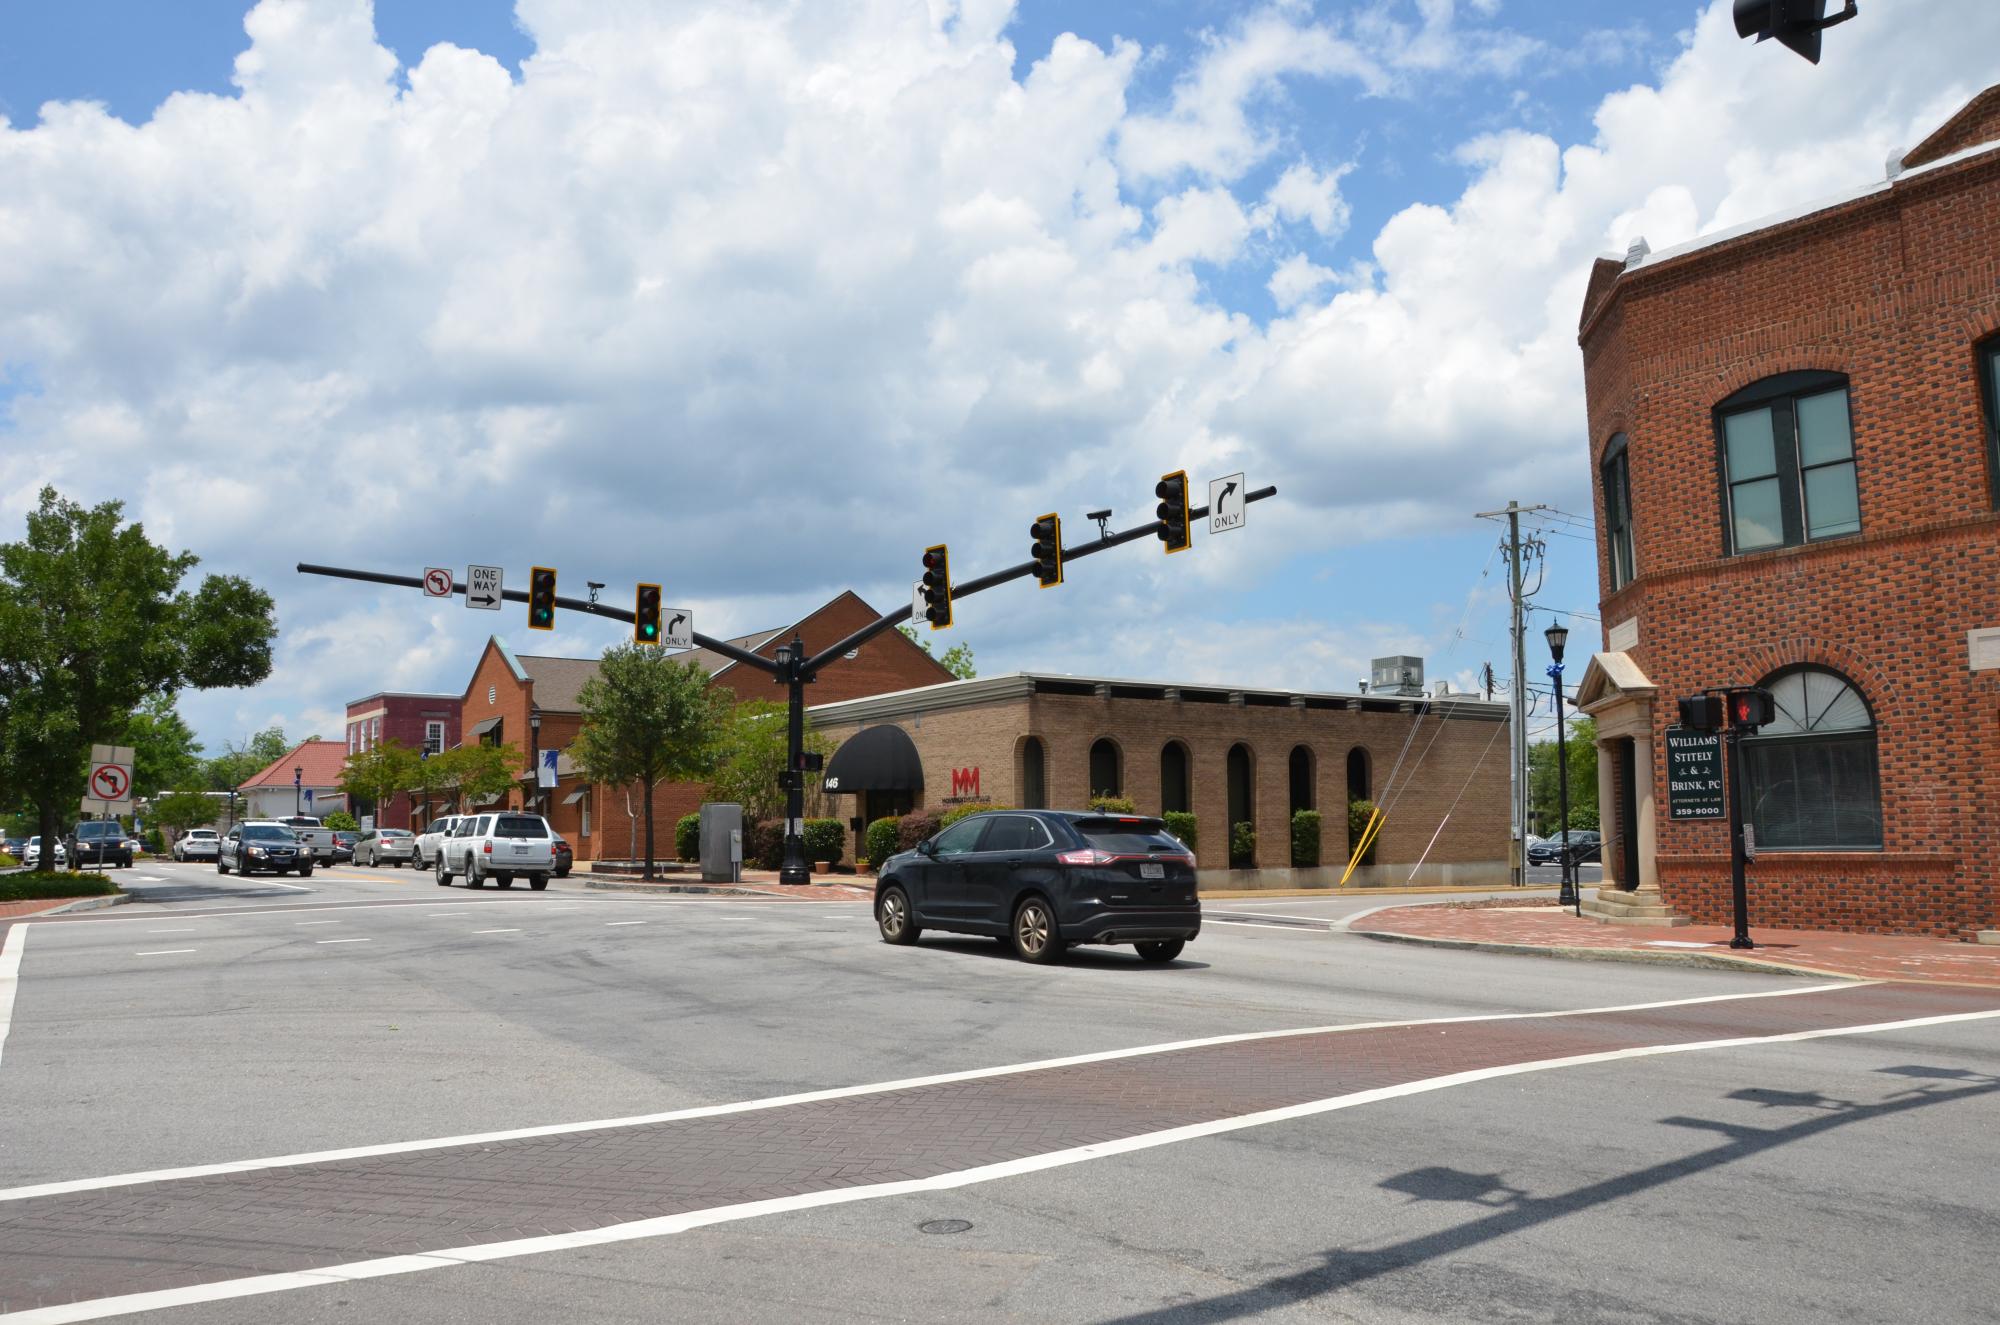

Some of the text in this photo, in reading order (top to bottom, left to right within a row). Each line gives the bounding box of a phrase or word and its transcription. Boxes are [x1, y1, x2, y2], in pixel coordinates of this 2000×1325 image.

[1215, 513, 1239, 529] ONLY
[474, 569, 497, 581] ONE
[474, 581, 497, 593] WAY
[665, 637, 688, 647] ONLY
[1669, 735, 1718, 748] WILLIAMS
[1674, 751, 1713, 763] STITELY
[1690, 766, 1699, 775] &
[826, 774, 839, 790] 146
[1671, 780, 1721, 791] BRINK, PC
[1676, 807, 1719, 816] 359-9000
